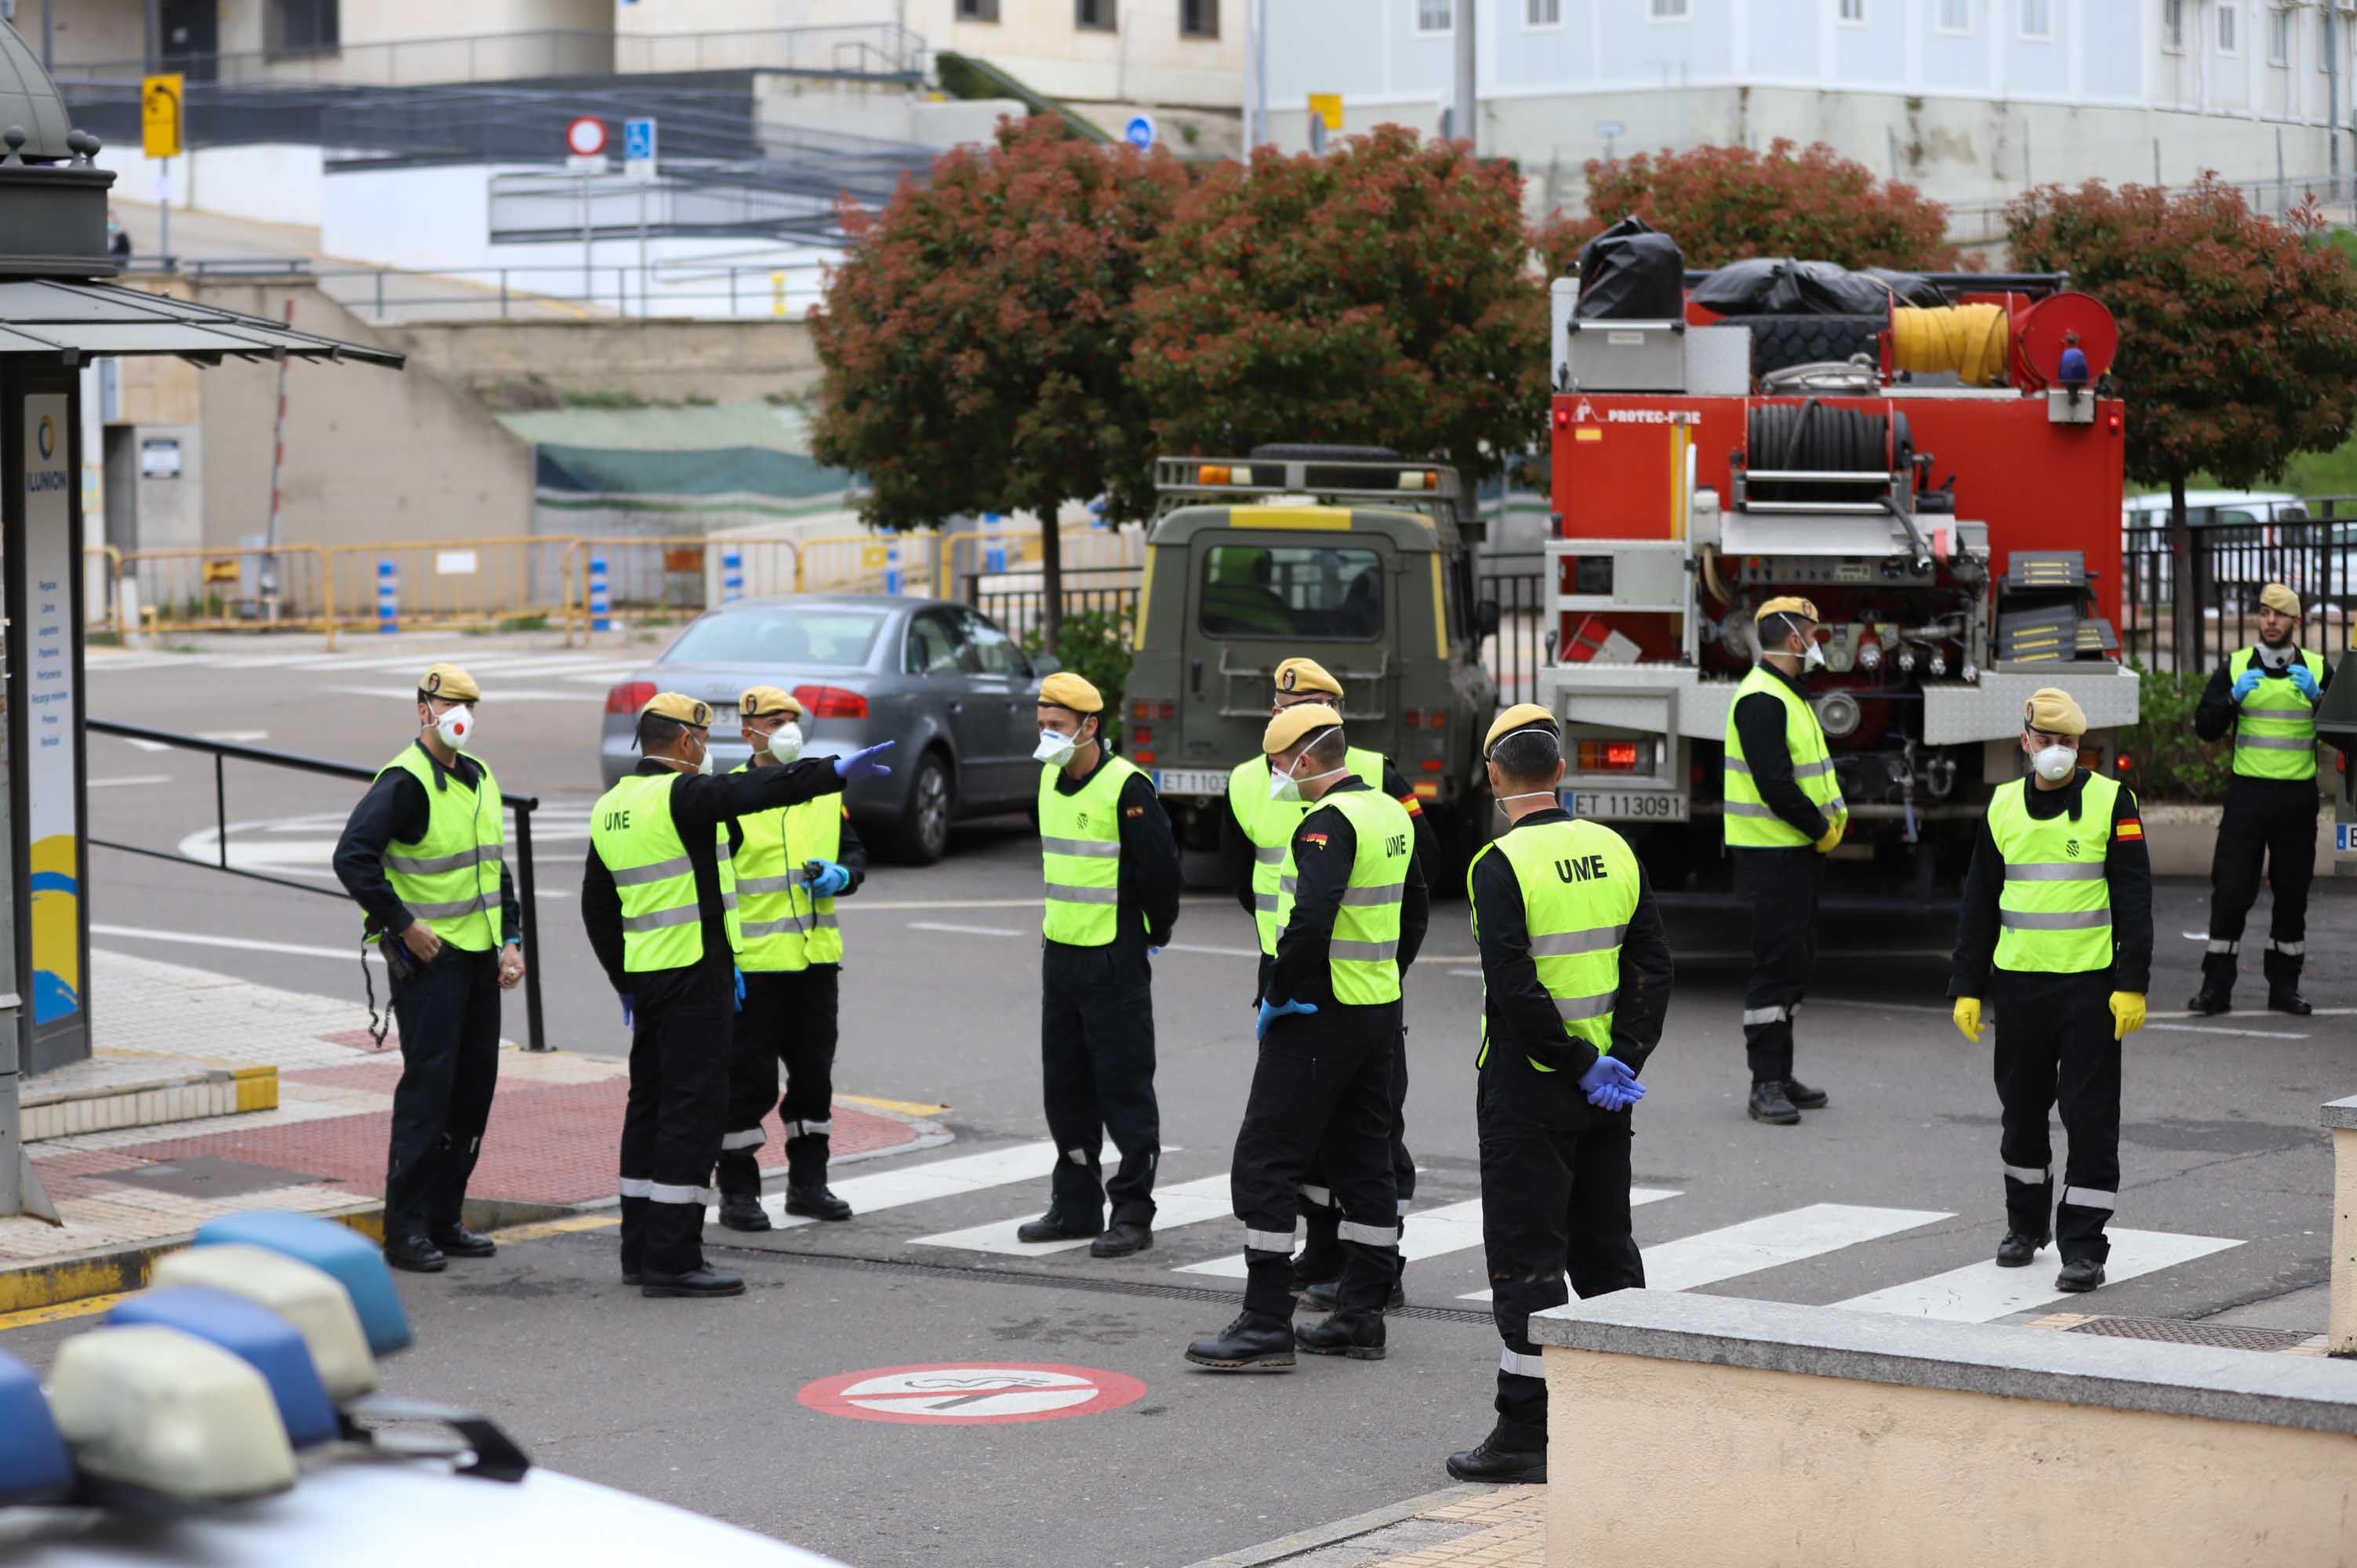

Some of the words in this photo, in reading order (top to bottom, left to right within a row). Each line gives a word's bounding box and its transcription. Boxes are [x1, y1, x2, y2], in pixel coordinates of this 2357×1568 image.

[1607, 408, 1701, 424] PROTEC-FRE
[1575, 794, 1600, 815] ET
[1611, 796, 1680, 816] 113091
[1386, 834, 1406, 858] UME
[1554, 855, 1608, 884] UME
